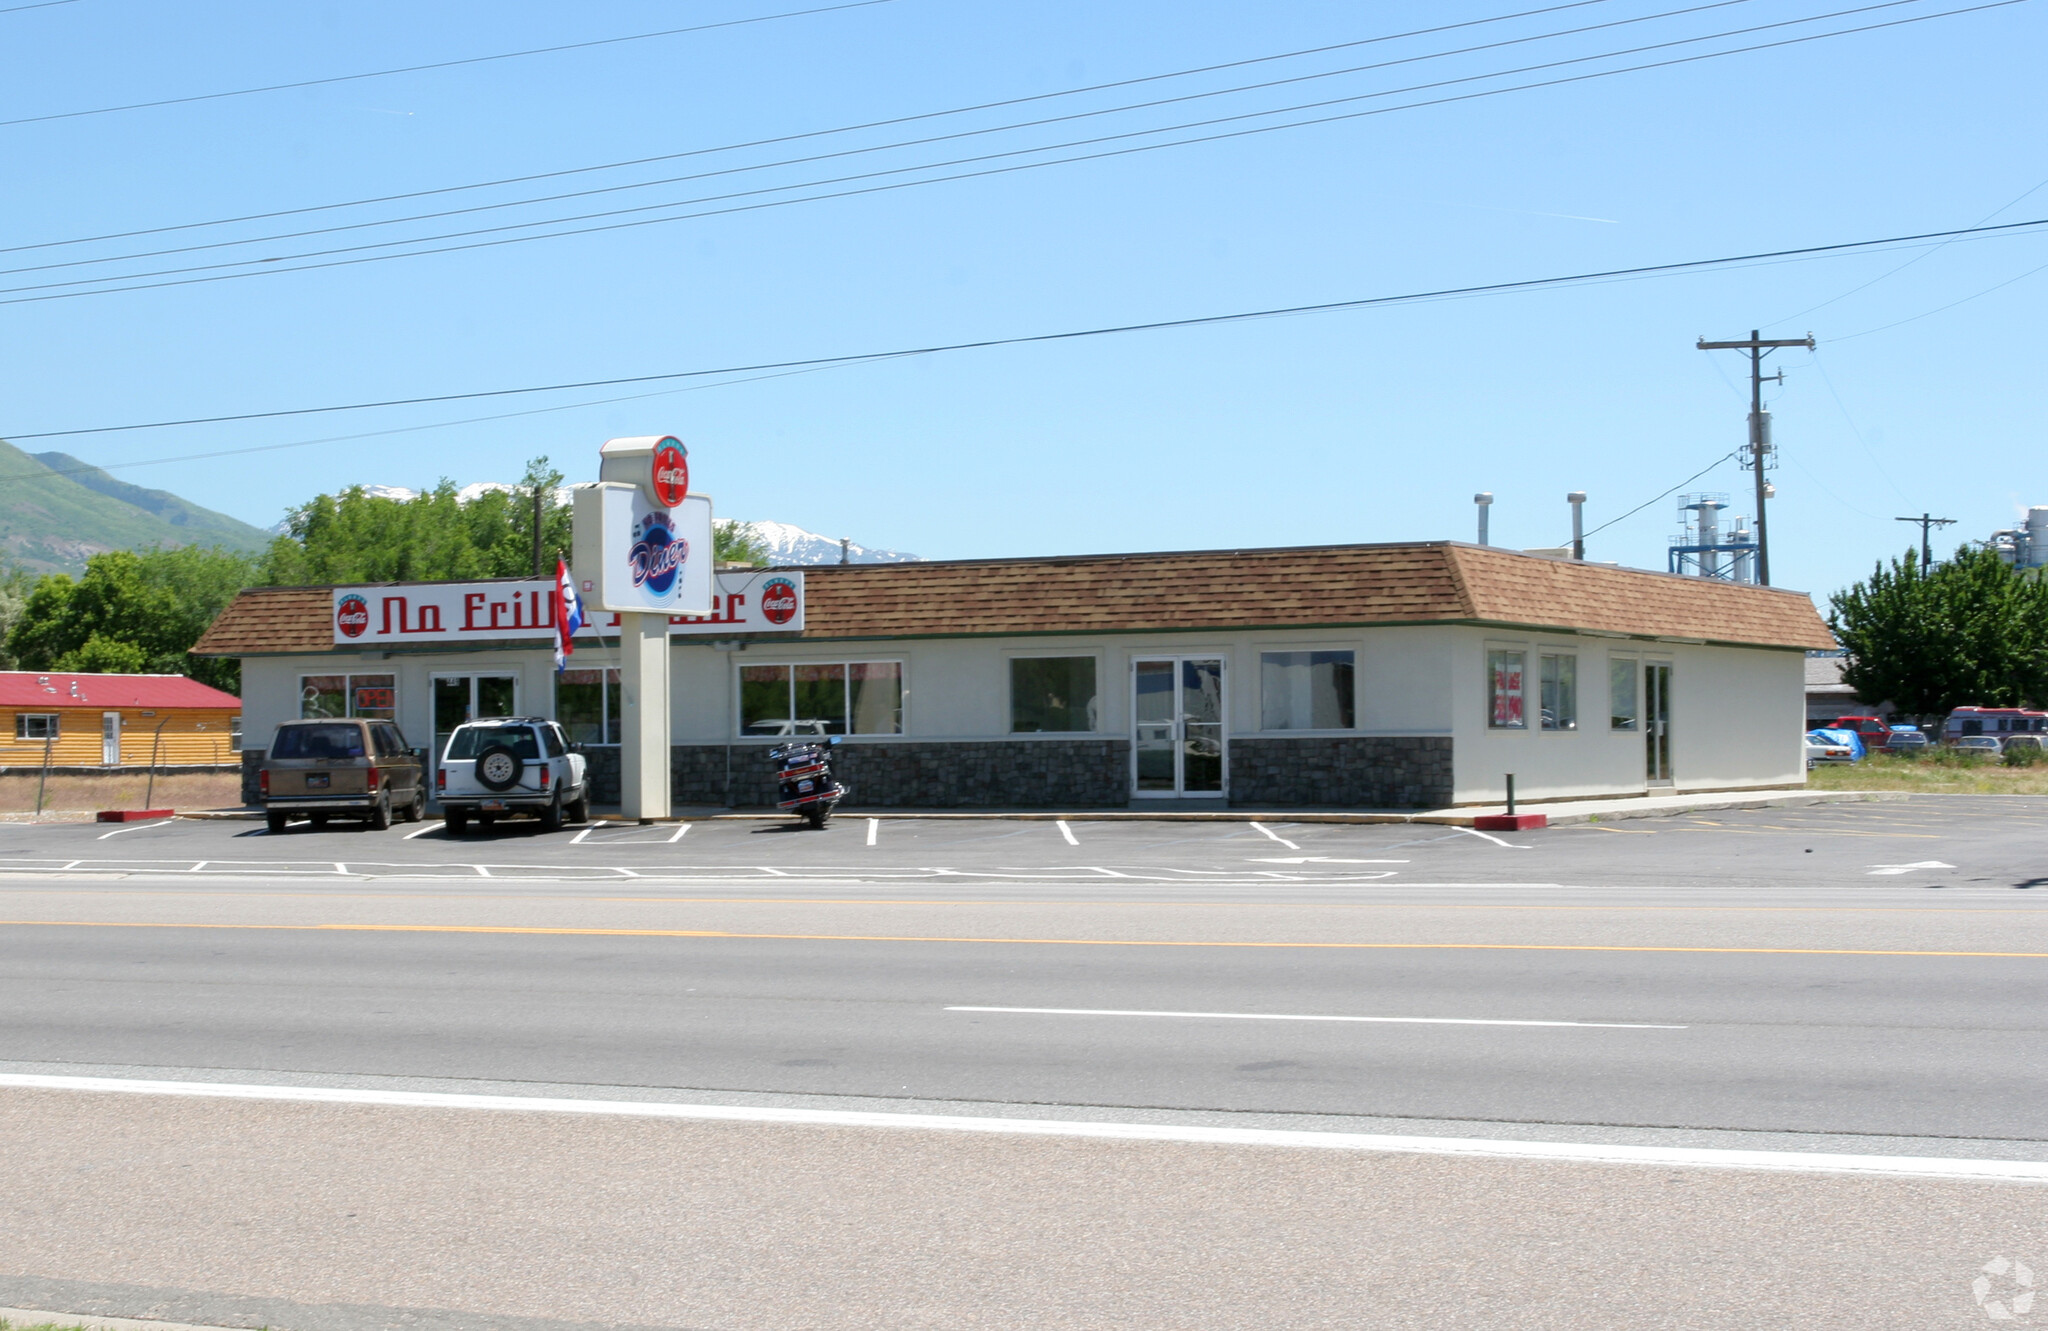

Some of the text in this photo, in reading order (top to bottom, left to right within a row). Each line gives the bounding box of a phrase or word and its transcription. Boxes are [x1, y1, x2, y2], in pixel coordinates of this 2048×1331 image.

[628, 539, 689, 588] Diner
[377, 596, 446, 635] No
[459, 591, 592, 632] Frill
